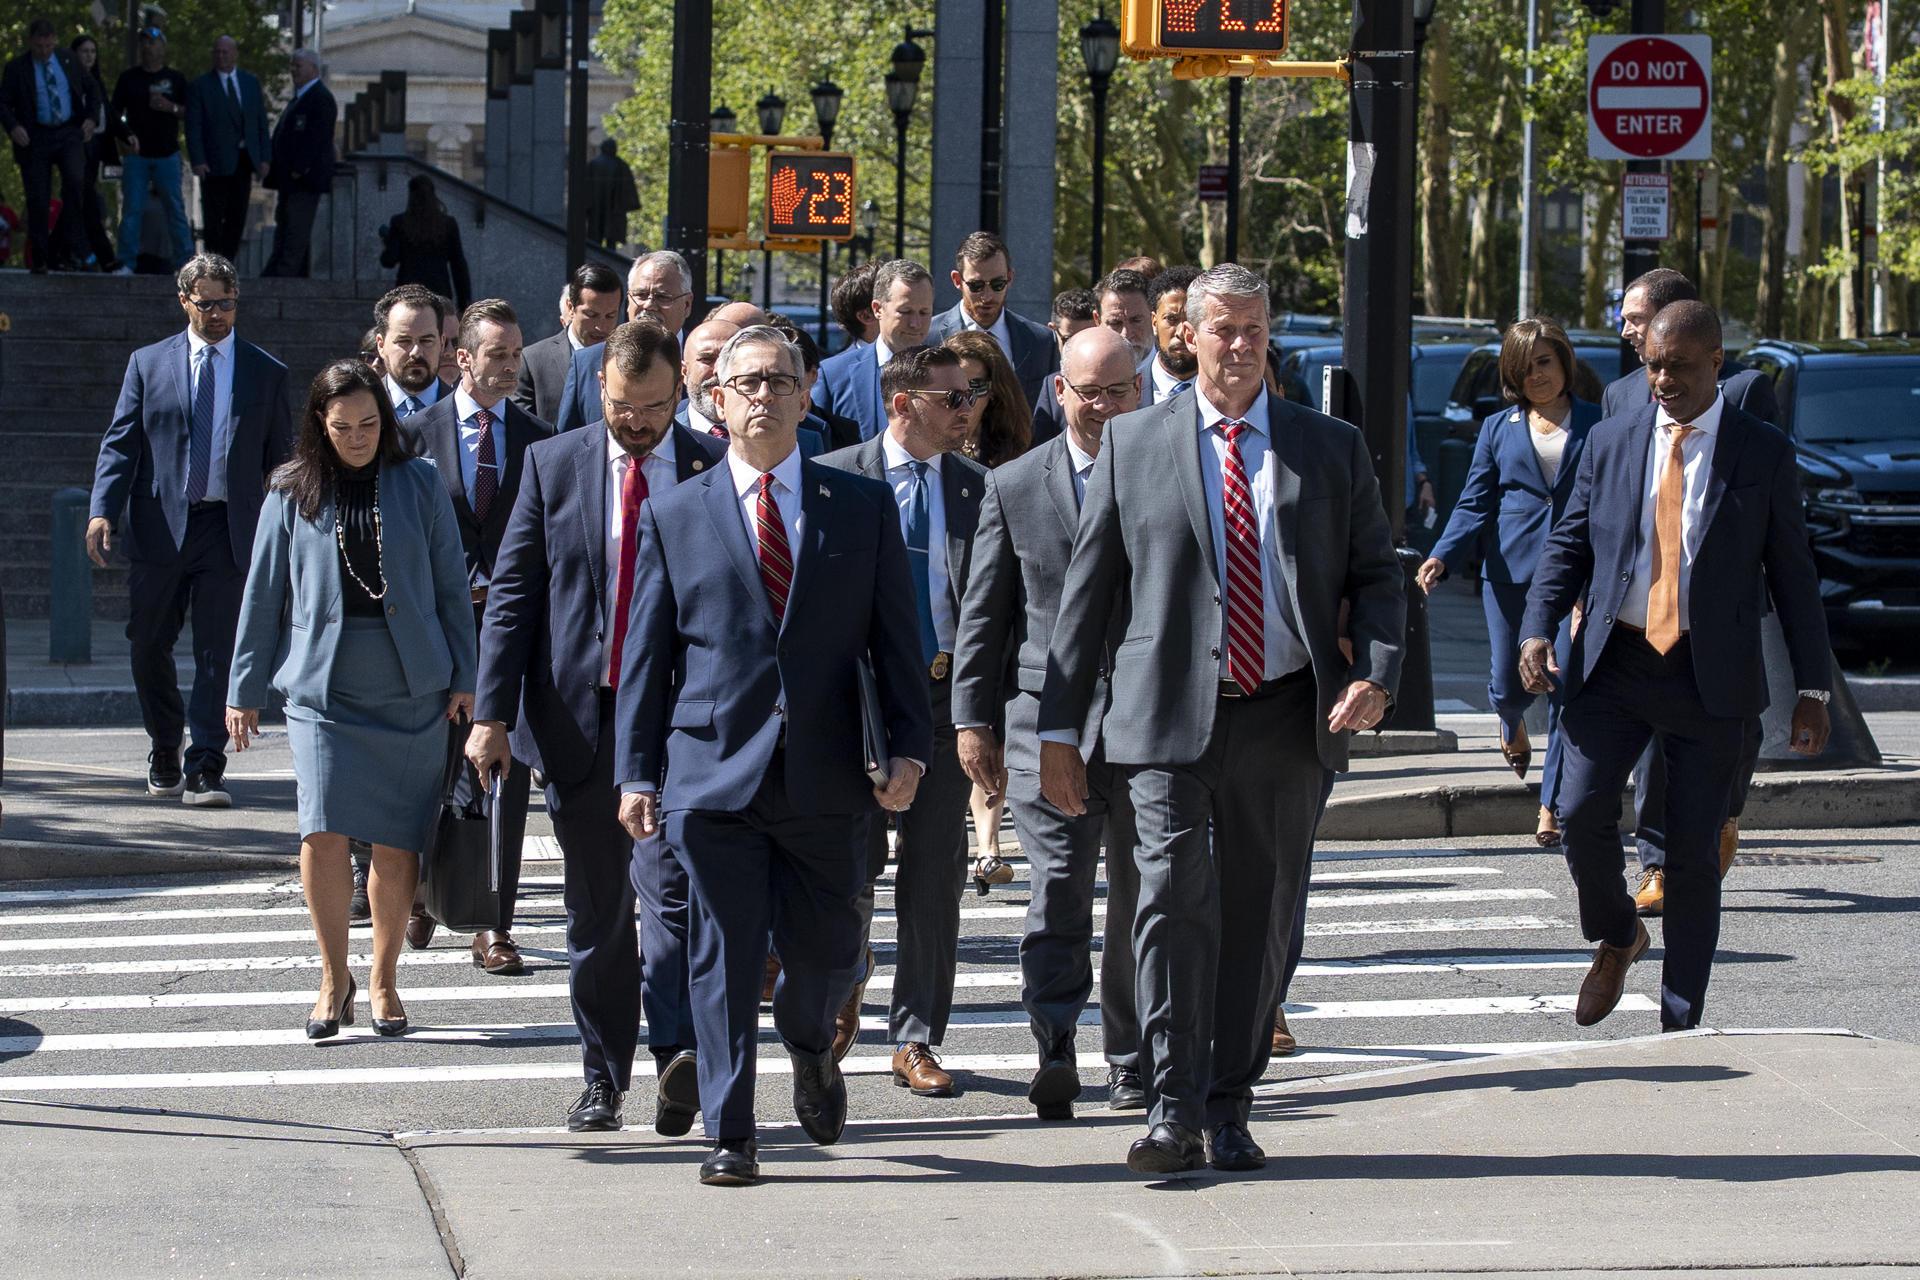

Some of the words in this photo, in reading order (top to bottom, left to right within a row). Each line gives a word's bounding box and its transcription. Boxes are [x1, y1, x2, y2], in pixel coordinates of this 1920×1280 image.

[1610, 61, 1640, 80] DO
[1647, 61, 1688, 80] NOT
[1616, 115, 1683, 134] ENTER
[808, 172, 852, 225] 23
[1626, 196, 1638, 204] YOU
[1631, 206, 1661, 215] ENTERING
[1632, 216, 1659, 225] FEDERAL
[1630, 227, 1661, 235] PROPERTY
